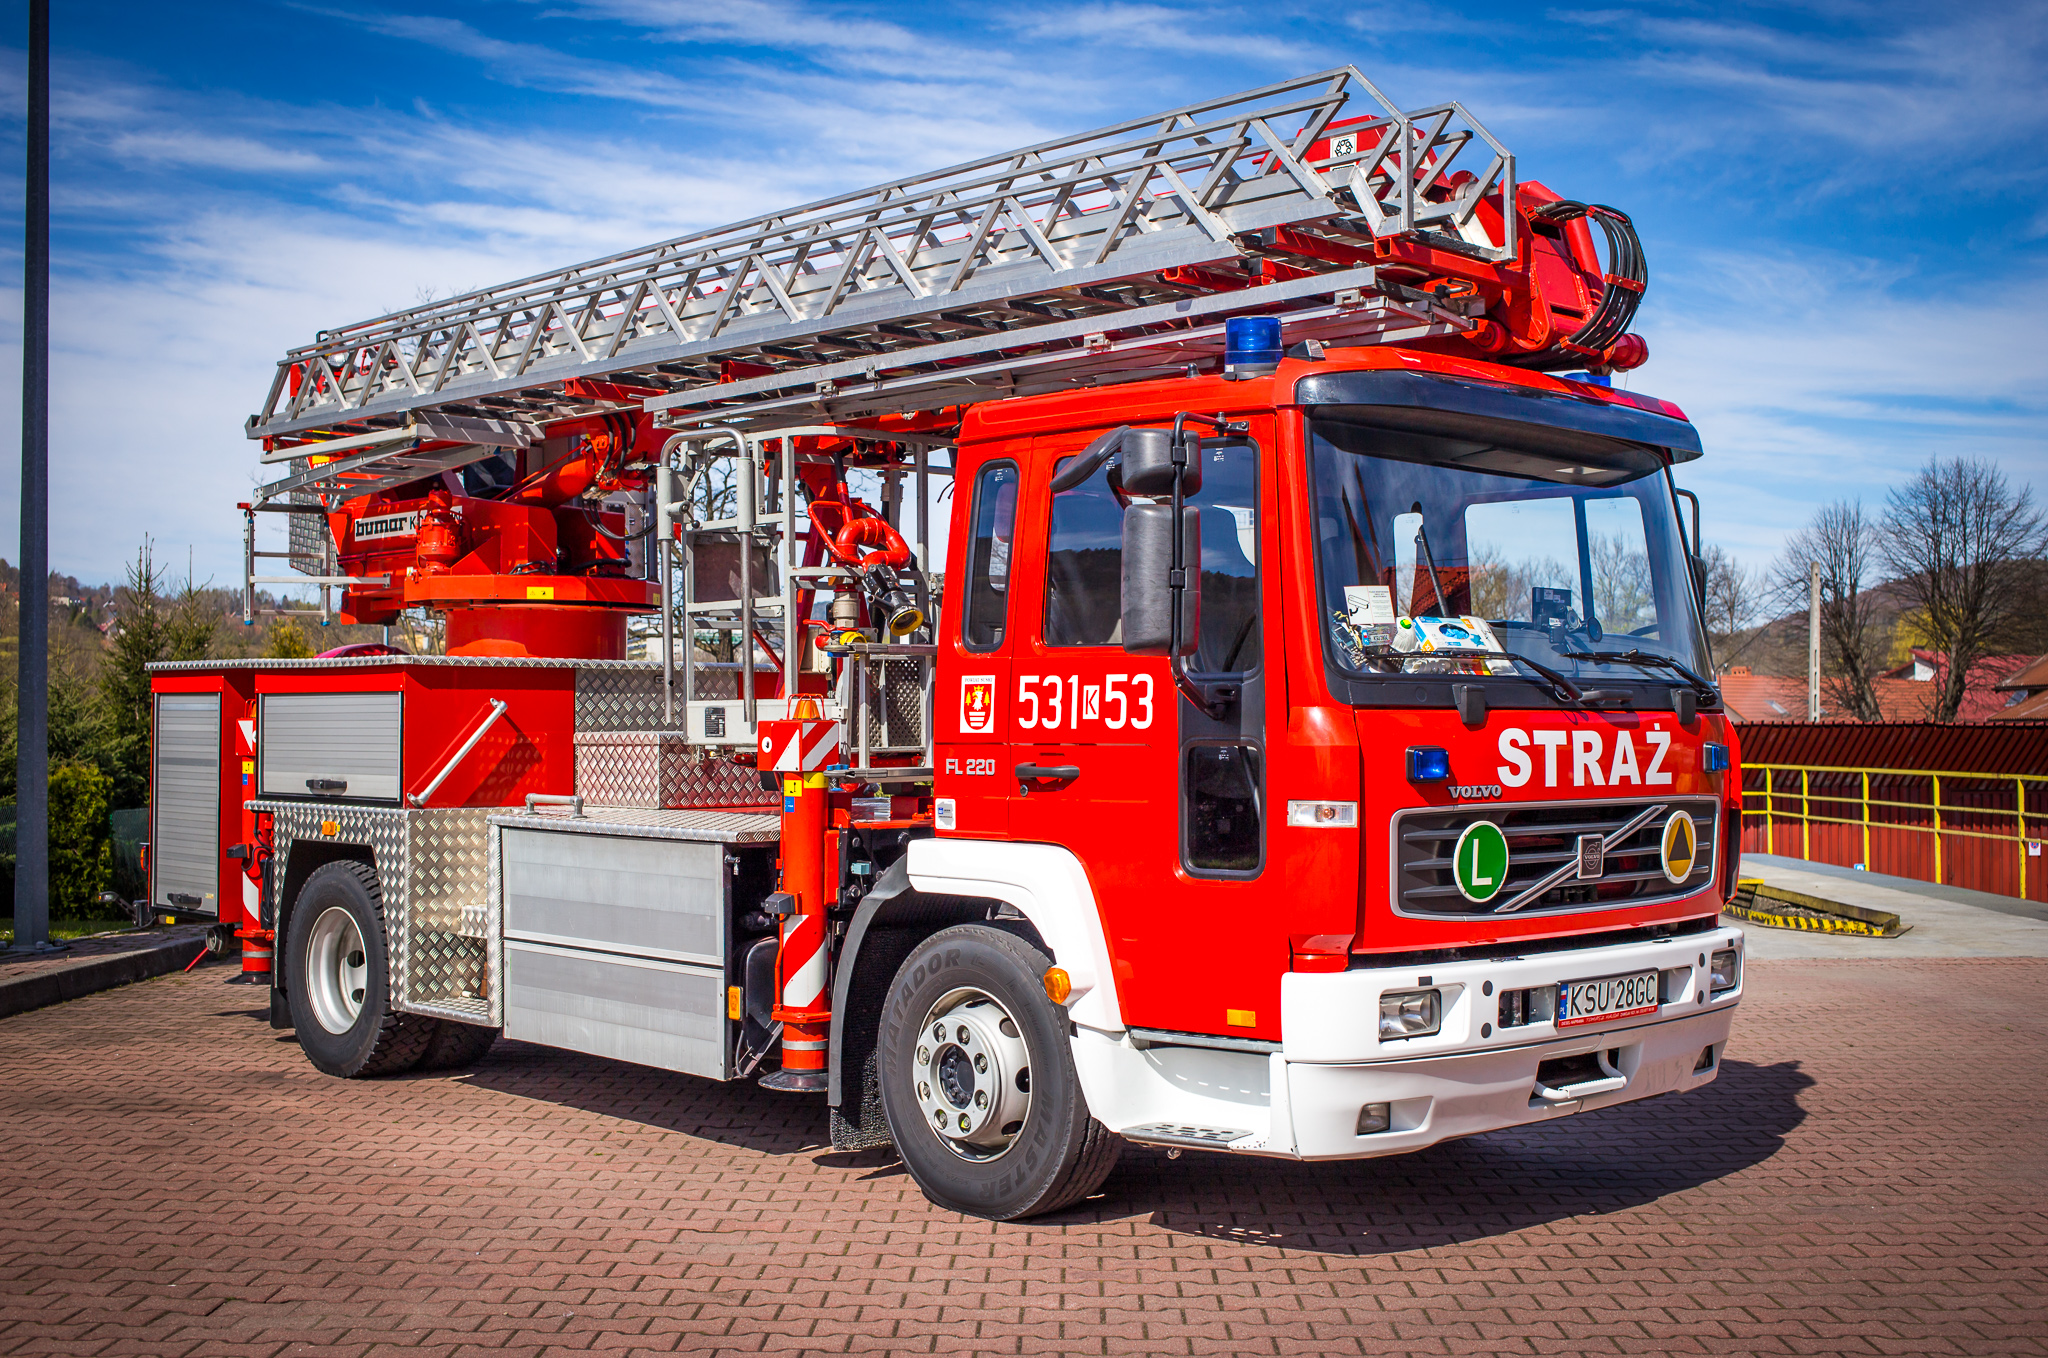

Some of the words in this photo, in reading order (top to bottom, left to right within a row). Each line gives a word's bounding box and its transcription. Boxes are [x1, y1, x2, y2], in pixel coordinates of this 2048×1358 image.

[355, 516, 408, 538] bumar
[945, 758, 964, 775] FL
[966, 758, 996, 776] 220
[1497, 722, 1673, 788] STRAŻ
[1447, 784, 1502, 799] VOLVO
[1471, 838, 1493, 886] L
[1559, 1006, 1566, 1015] PL
[1570, 981, 1610, 1017] KSU
[1614, 974, 1656, 1010] 28GC
[884, 948, 961, 1080] MATADOR
